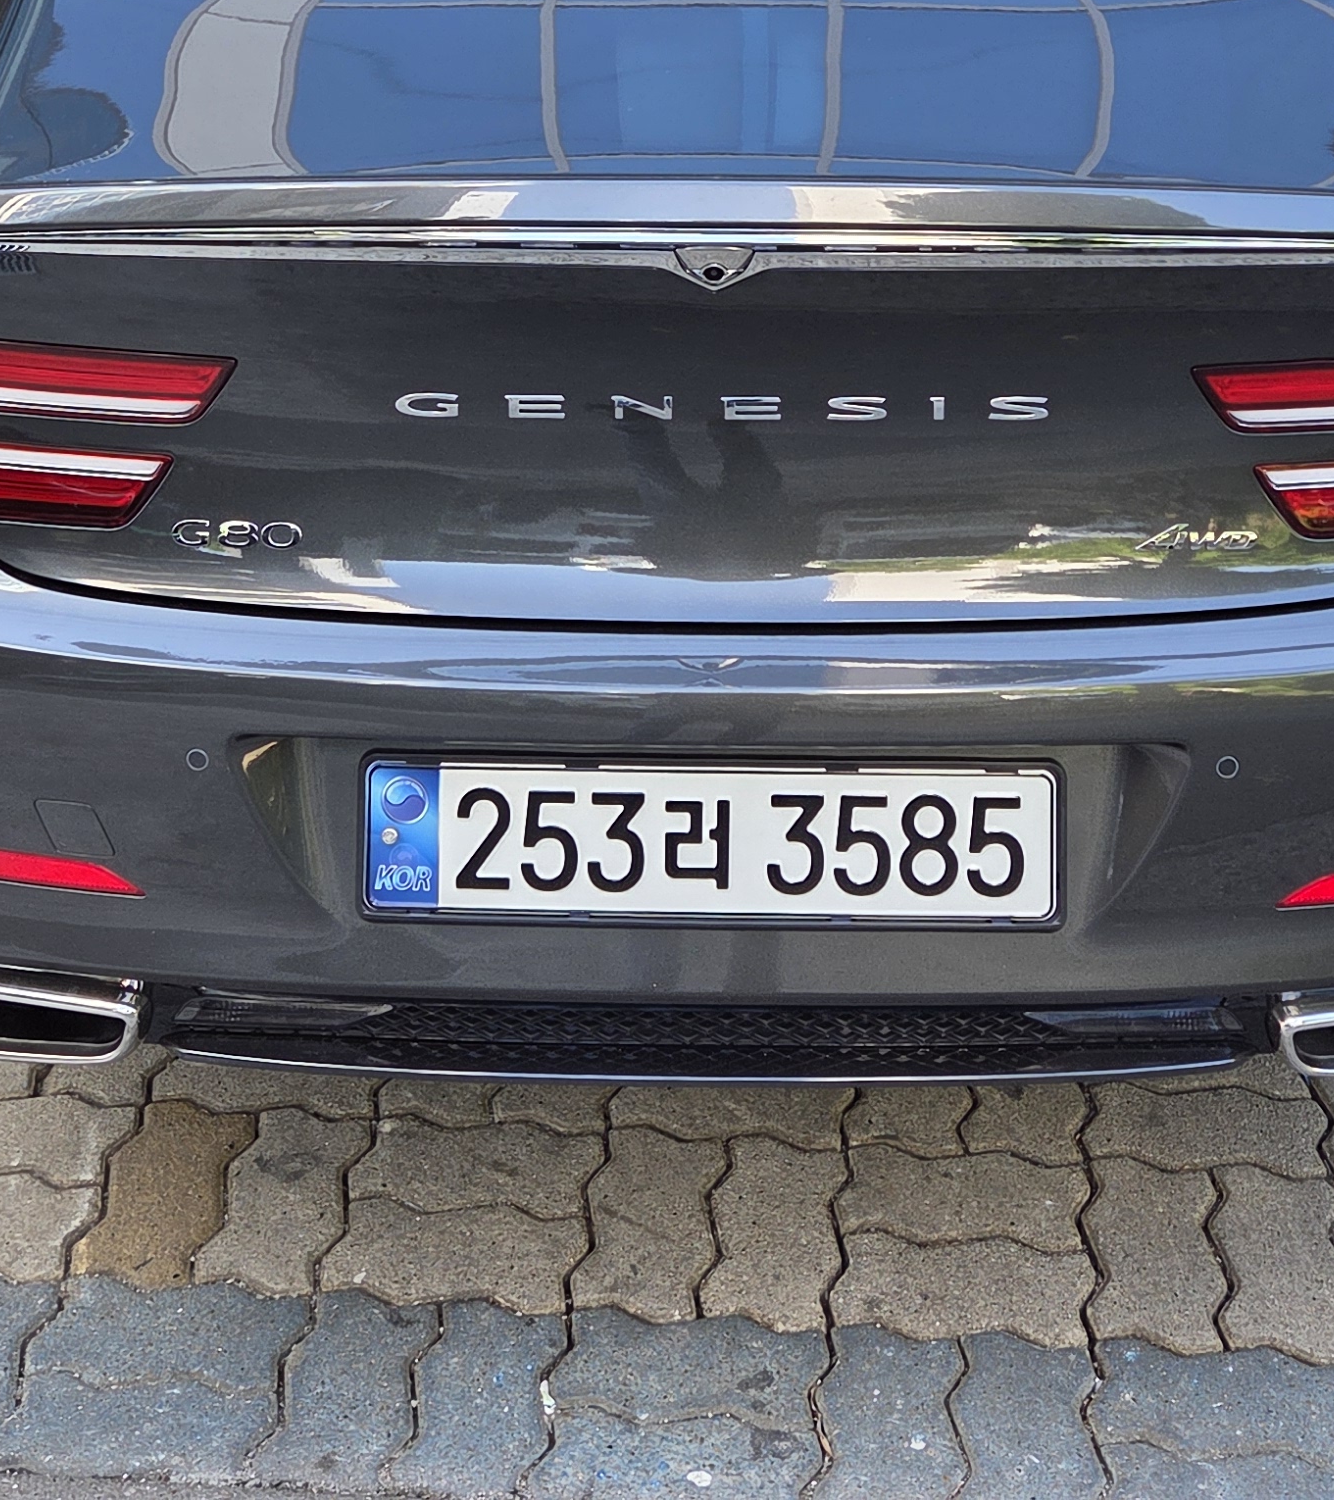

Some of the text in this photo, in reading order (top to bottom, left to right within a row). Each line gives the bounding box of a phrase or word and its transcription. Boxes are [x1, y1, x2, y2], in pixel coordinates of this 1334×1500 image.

[394, 392, 1050, 421] GENESIS
[171, 518, 303, 550] G80
[1134, 522, 1260, 551] AWD
[455, 787, 1024, 897] 253러 3585
[374, 864, 433, 892] KOR
